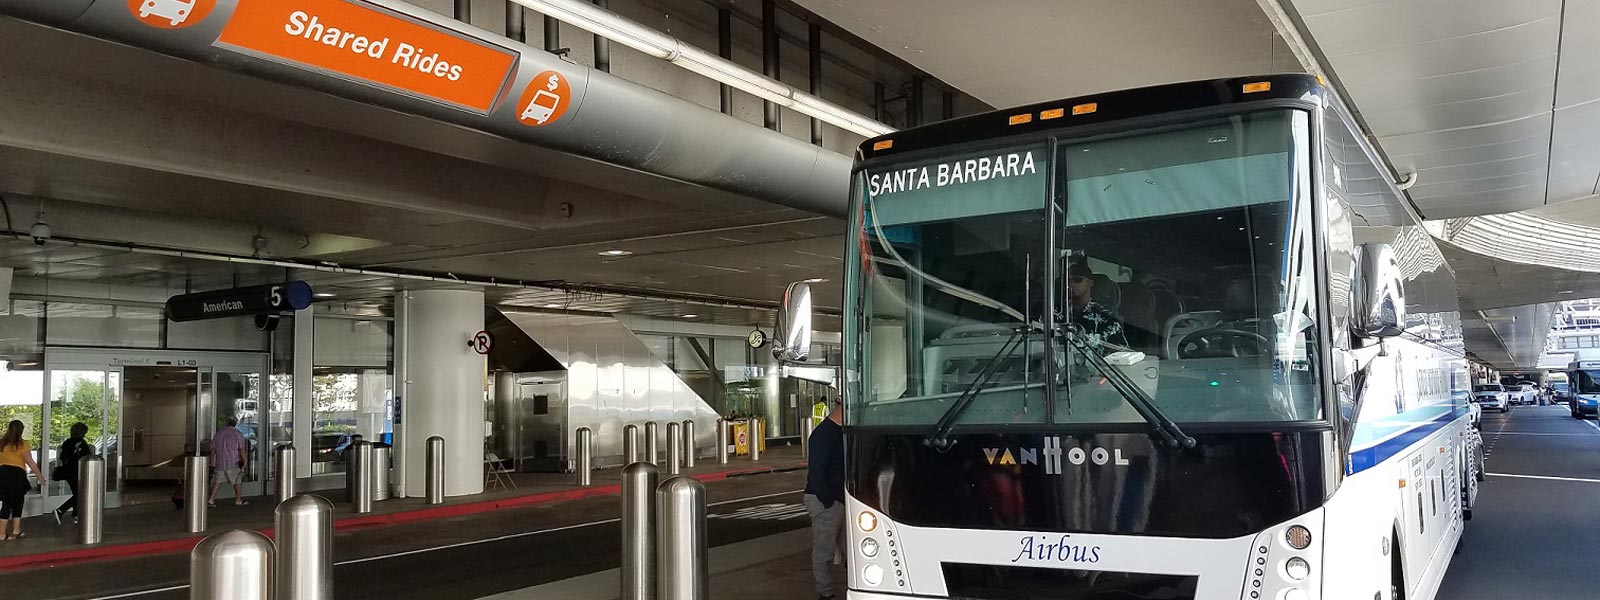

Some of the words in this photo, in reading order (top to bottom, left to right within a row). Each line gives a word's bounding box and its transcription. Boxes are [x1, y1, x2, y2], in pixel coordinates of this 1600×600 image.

[285, 10, 389, 59] Shared
[392, 42, 463, 81] Rides
[870, 166, 930, 197] SANTA
[937, 151, 1036, 187] BARBARA
[203, 300, 243, 313] American
[271, 286, 281, 307] 5
[1011, 534, 1101, 564] Airbus
